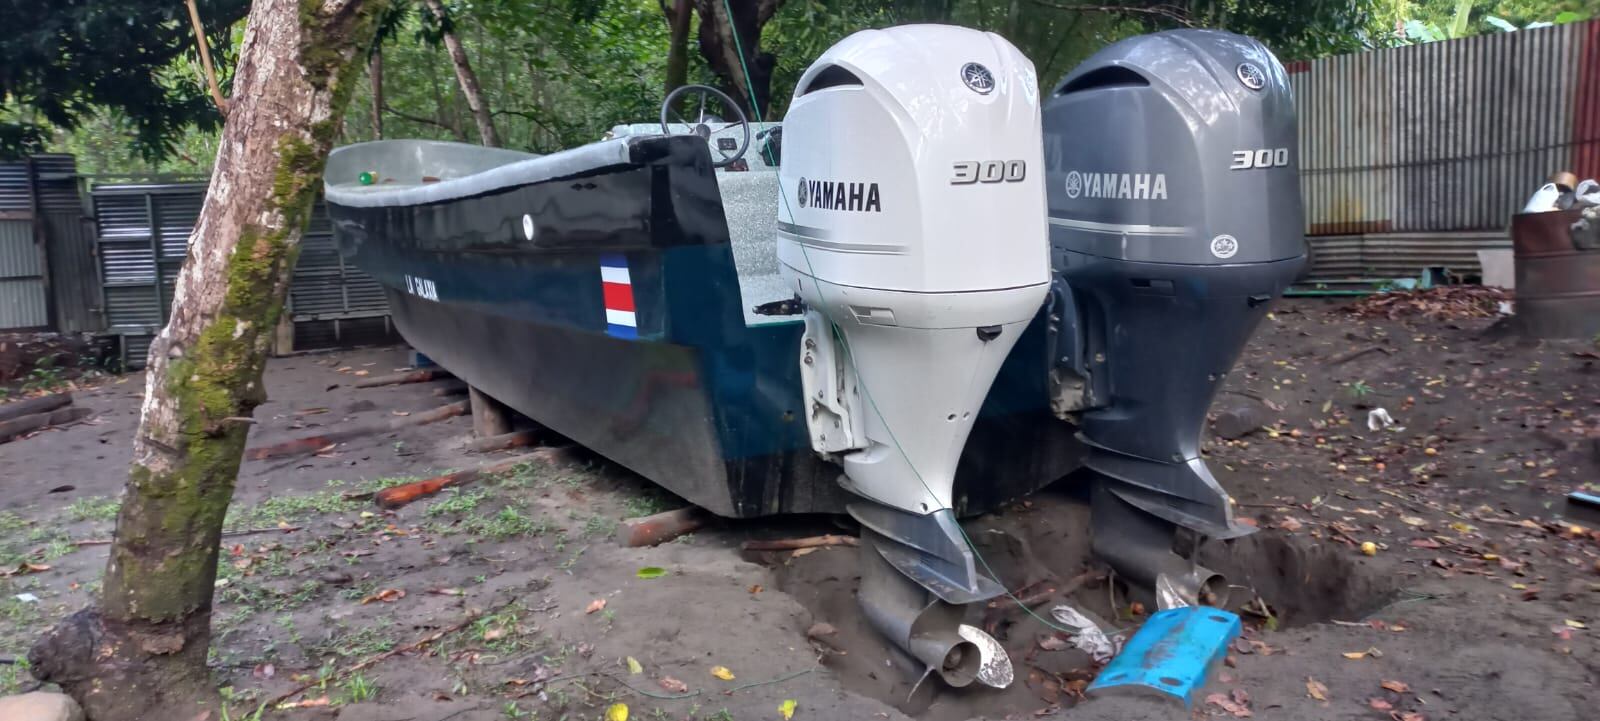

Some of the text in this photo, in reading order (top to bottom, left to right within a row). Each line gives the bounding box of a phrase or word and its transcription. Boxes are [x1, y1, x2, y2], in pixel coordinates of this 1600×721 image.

[1230, 148, 1288, 169] 300
[951, 160, 1026, 185] 300
[808, 180, 881, 212] YAMAHA
[1083, 173, 1168, 199] YAMAHA
